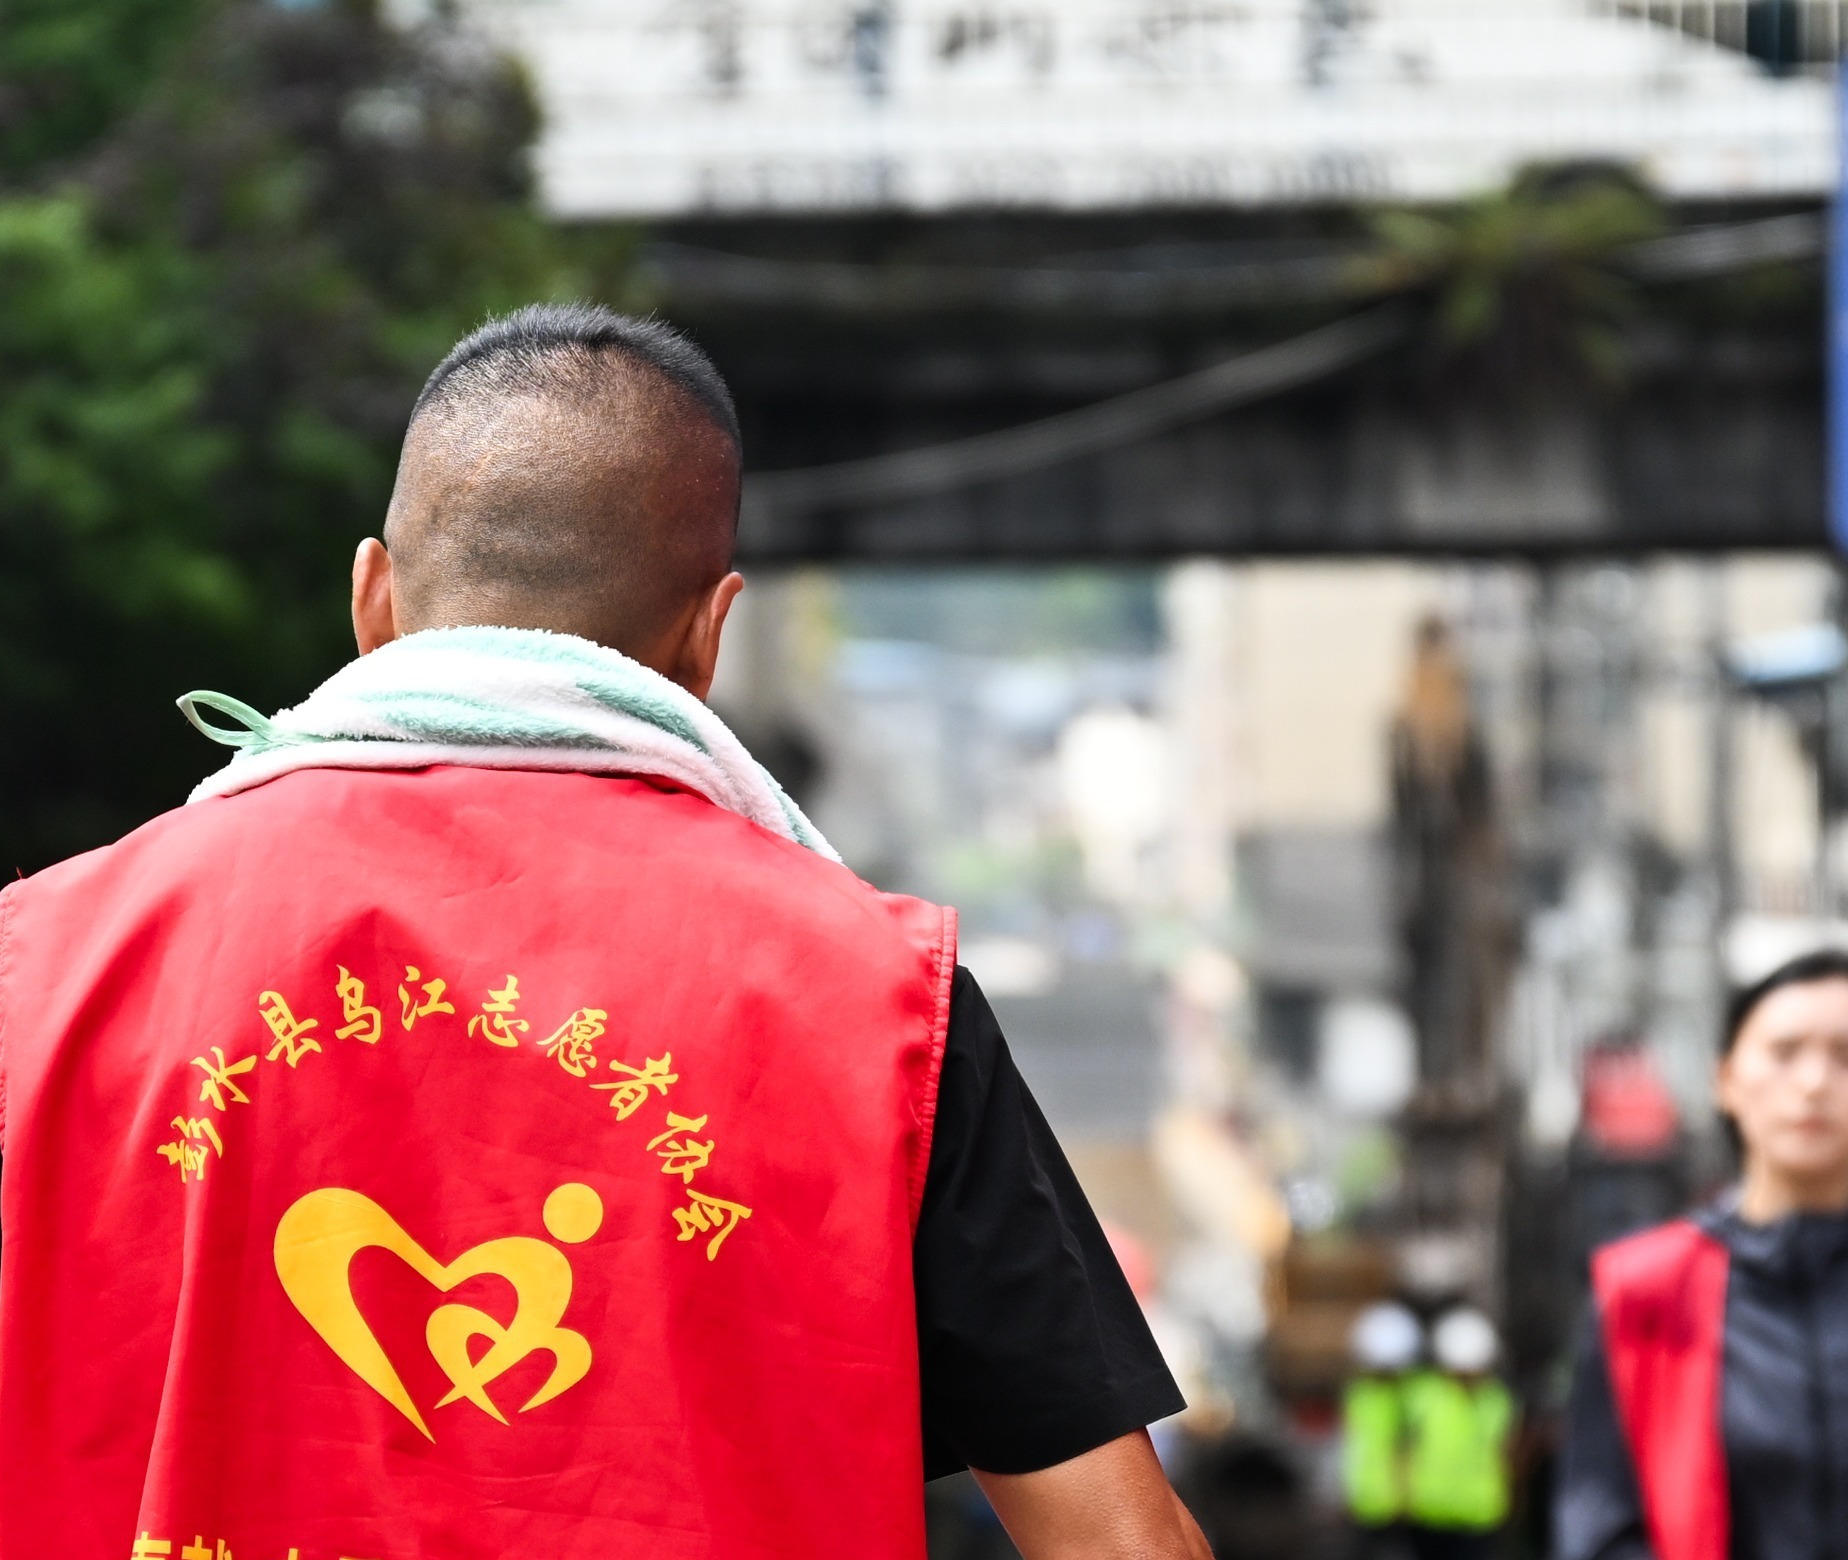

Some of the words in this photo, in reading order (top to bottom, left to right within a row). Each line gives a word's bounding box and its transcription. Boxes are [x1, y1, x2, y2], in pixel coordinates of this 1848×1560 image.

[156, 965, 753, 1262] 彭水县乌江志愿者协会
